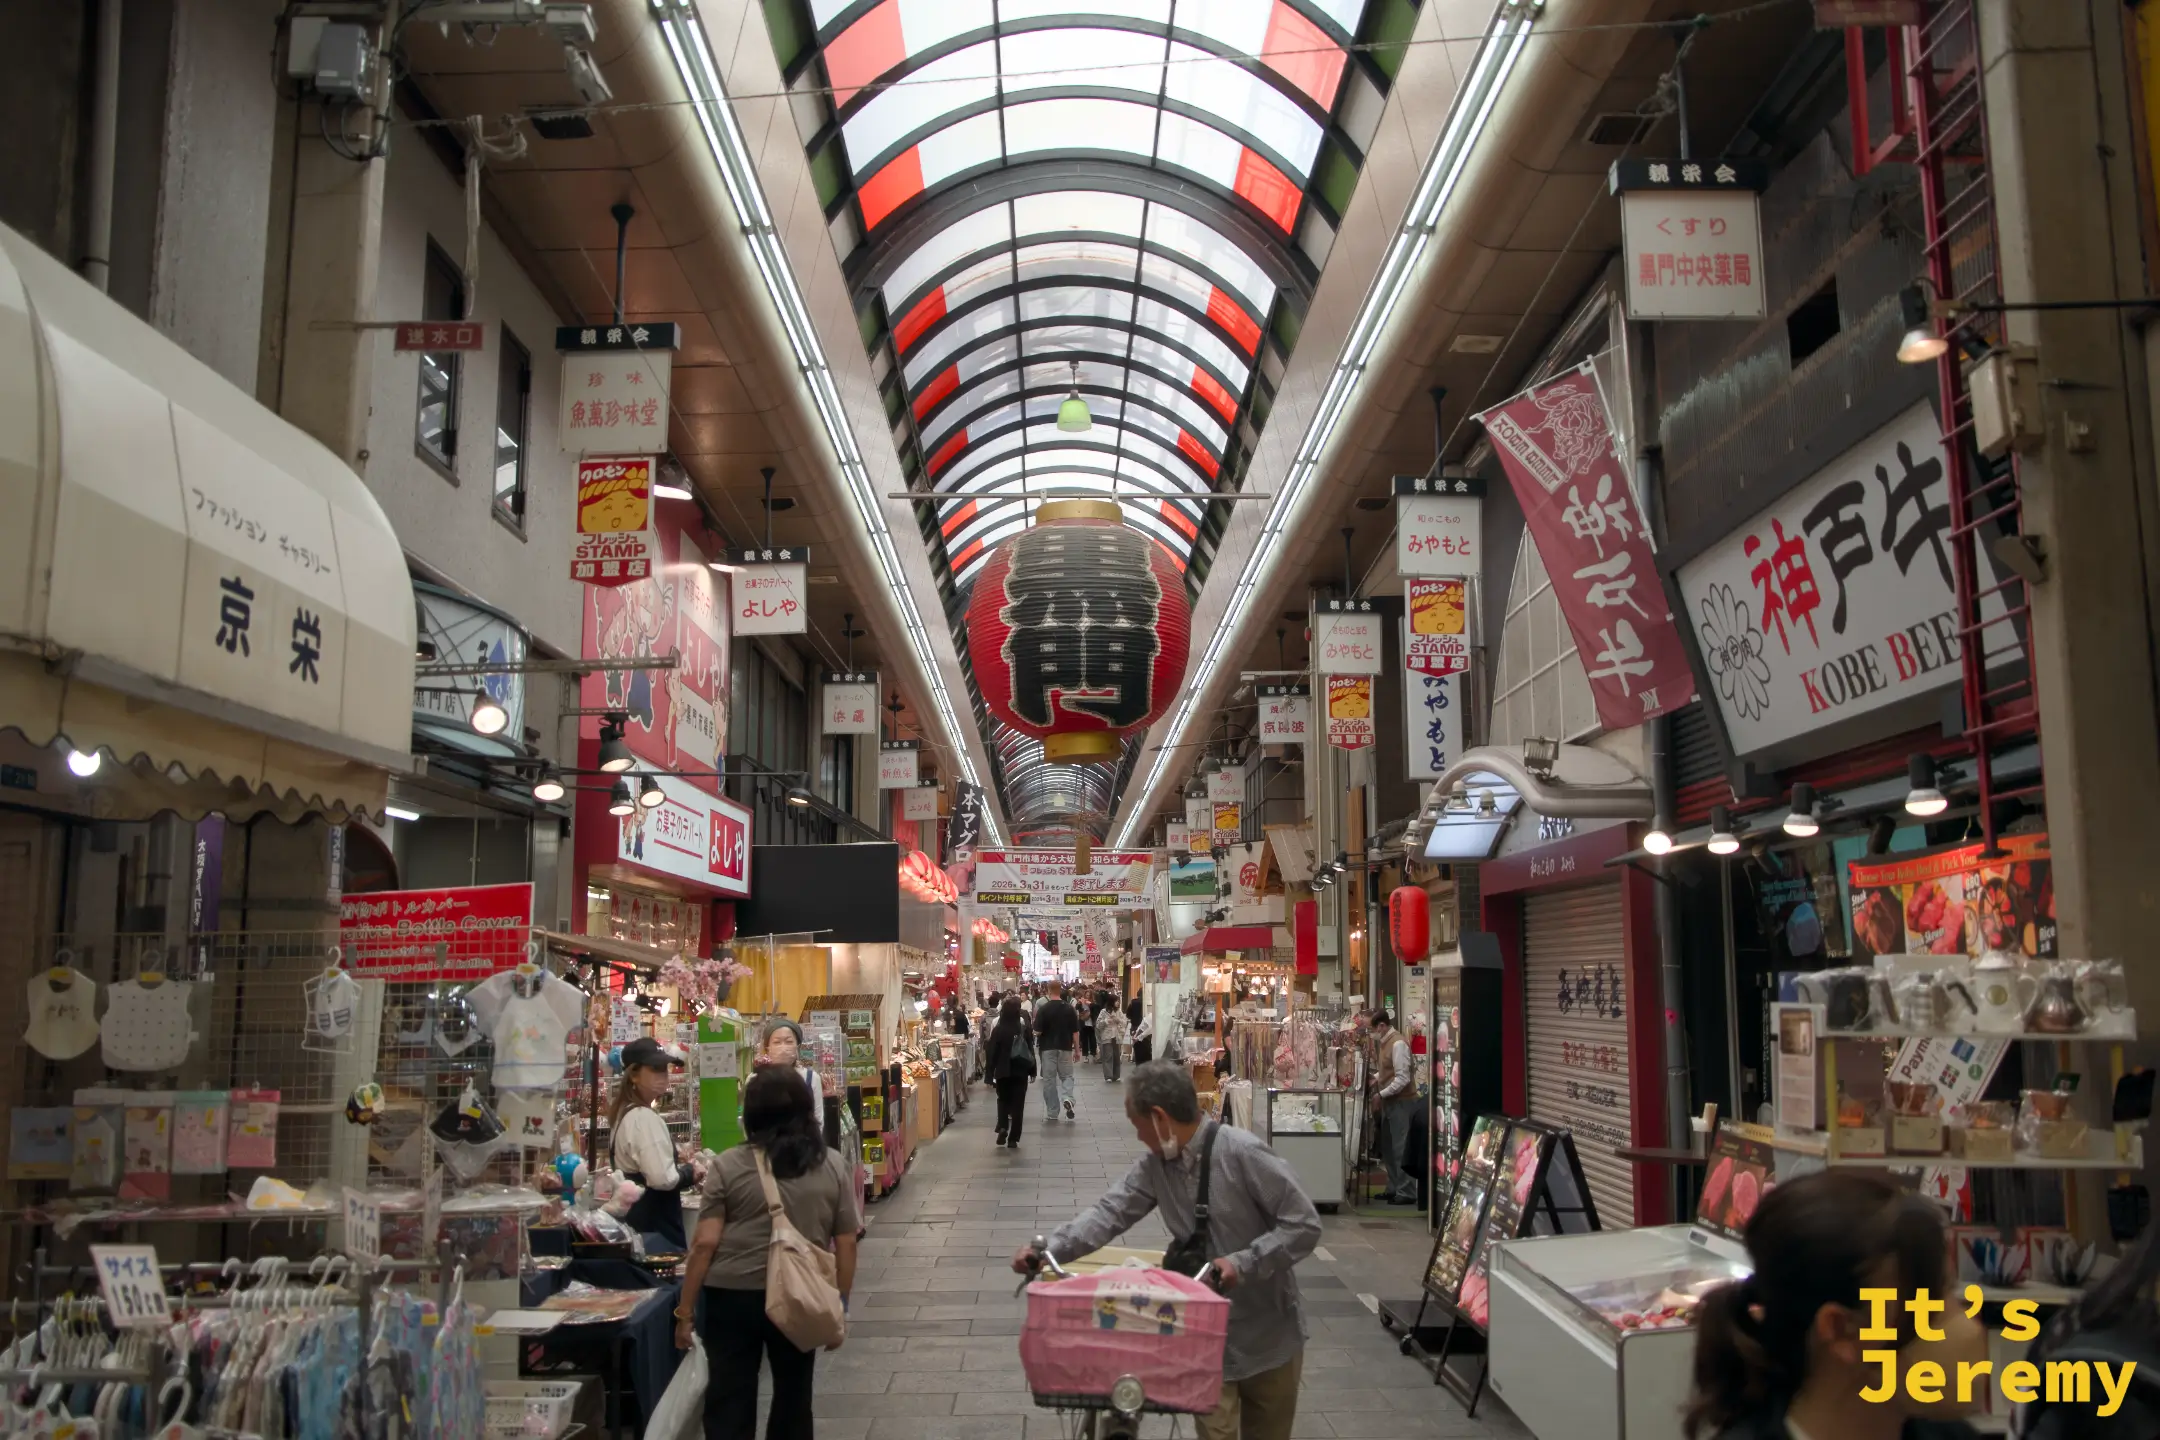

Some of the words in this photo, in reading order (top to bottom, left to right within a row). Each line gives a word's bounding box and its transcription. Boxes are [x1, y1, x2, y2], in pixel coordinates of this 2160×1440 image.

[1656, 217, 1727, 236] くすり
[1639, 252, 1752, 287] 黒門中央薬局
[407, 328, 474, 344] 送水口
[588, 372, 644, 388] 珍味
[570, 397, 659, 429] 魚萬珍味堂
[1494, 418, 1530, 457] KOBE
[1525, 450, 1560, 485] BEEF
[581, 465, 627, 484] クロモン
[192, 488, 267, 543] ファッション
[1417, 514, 1461, 523] 和のこもの
[582, 533, 638, 545] フレッシュ
[1408, 535, 1470, 555] みやもと
[1744, 440, 1956, 656] 神戸牛
[576, 543, 646, 558] STAMP
[576, 561, 646, 577] 加盟店
[1412, 584, 1446, 594] クロモン
[1561, 474, 1655, 698] 神戸牛
[742, 599, 797, 617] よしや
[215, 575, 321, 686] 京栄
[1414, 634, 1458, 644] フレッシュ
[1326, 644, 1374, 660] みやもと
[1410, 644, 1464, 655] STAMP
[682, 626, 721, 700] よしや
[1410, 656, 1464, 669] 加盟店
[1799, 643, 1888, 714] KOBE
[1885, 606, 1962, 683] BEE
[1330, 679, 1356, 688] クロモン
[1330, 725, 1371, 733] STAMP
[1331, 735, 1371, 744] 加盟店
[656, 809, 703, 849] お菓子のデパート
[955, 788, 979, 862] 本マグロ
[710, 818, 744, 872] よしや
[1856, 870, 1879, 883] Choose
[1942, 858, 1959, 870] Pick
[1960, 853, 1978, 866] Your
[1966, 872, 1980, 887] BBQ
[397, 917, 456, 936] Bottle
[462, 914, 522, 932] Cover
[2039, 925, 2056, 940] Rice
